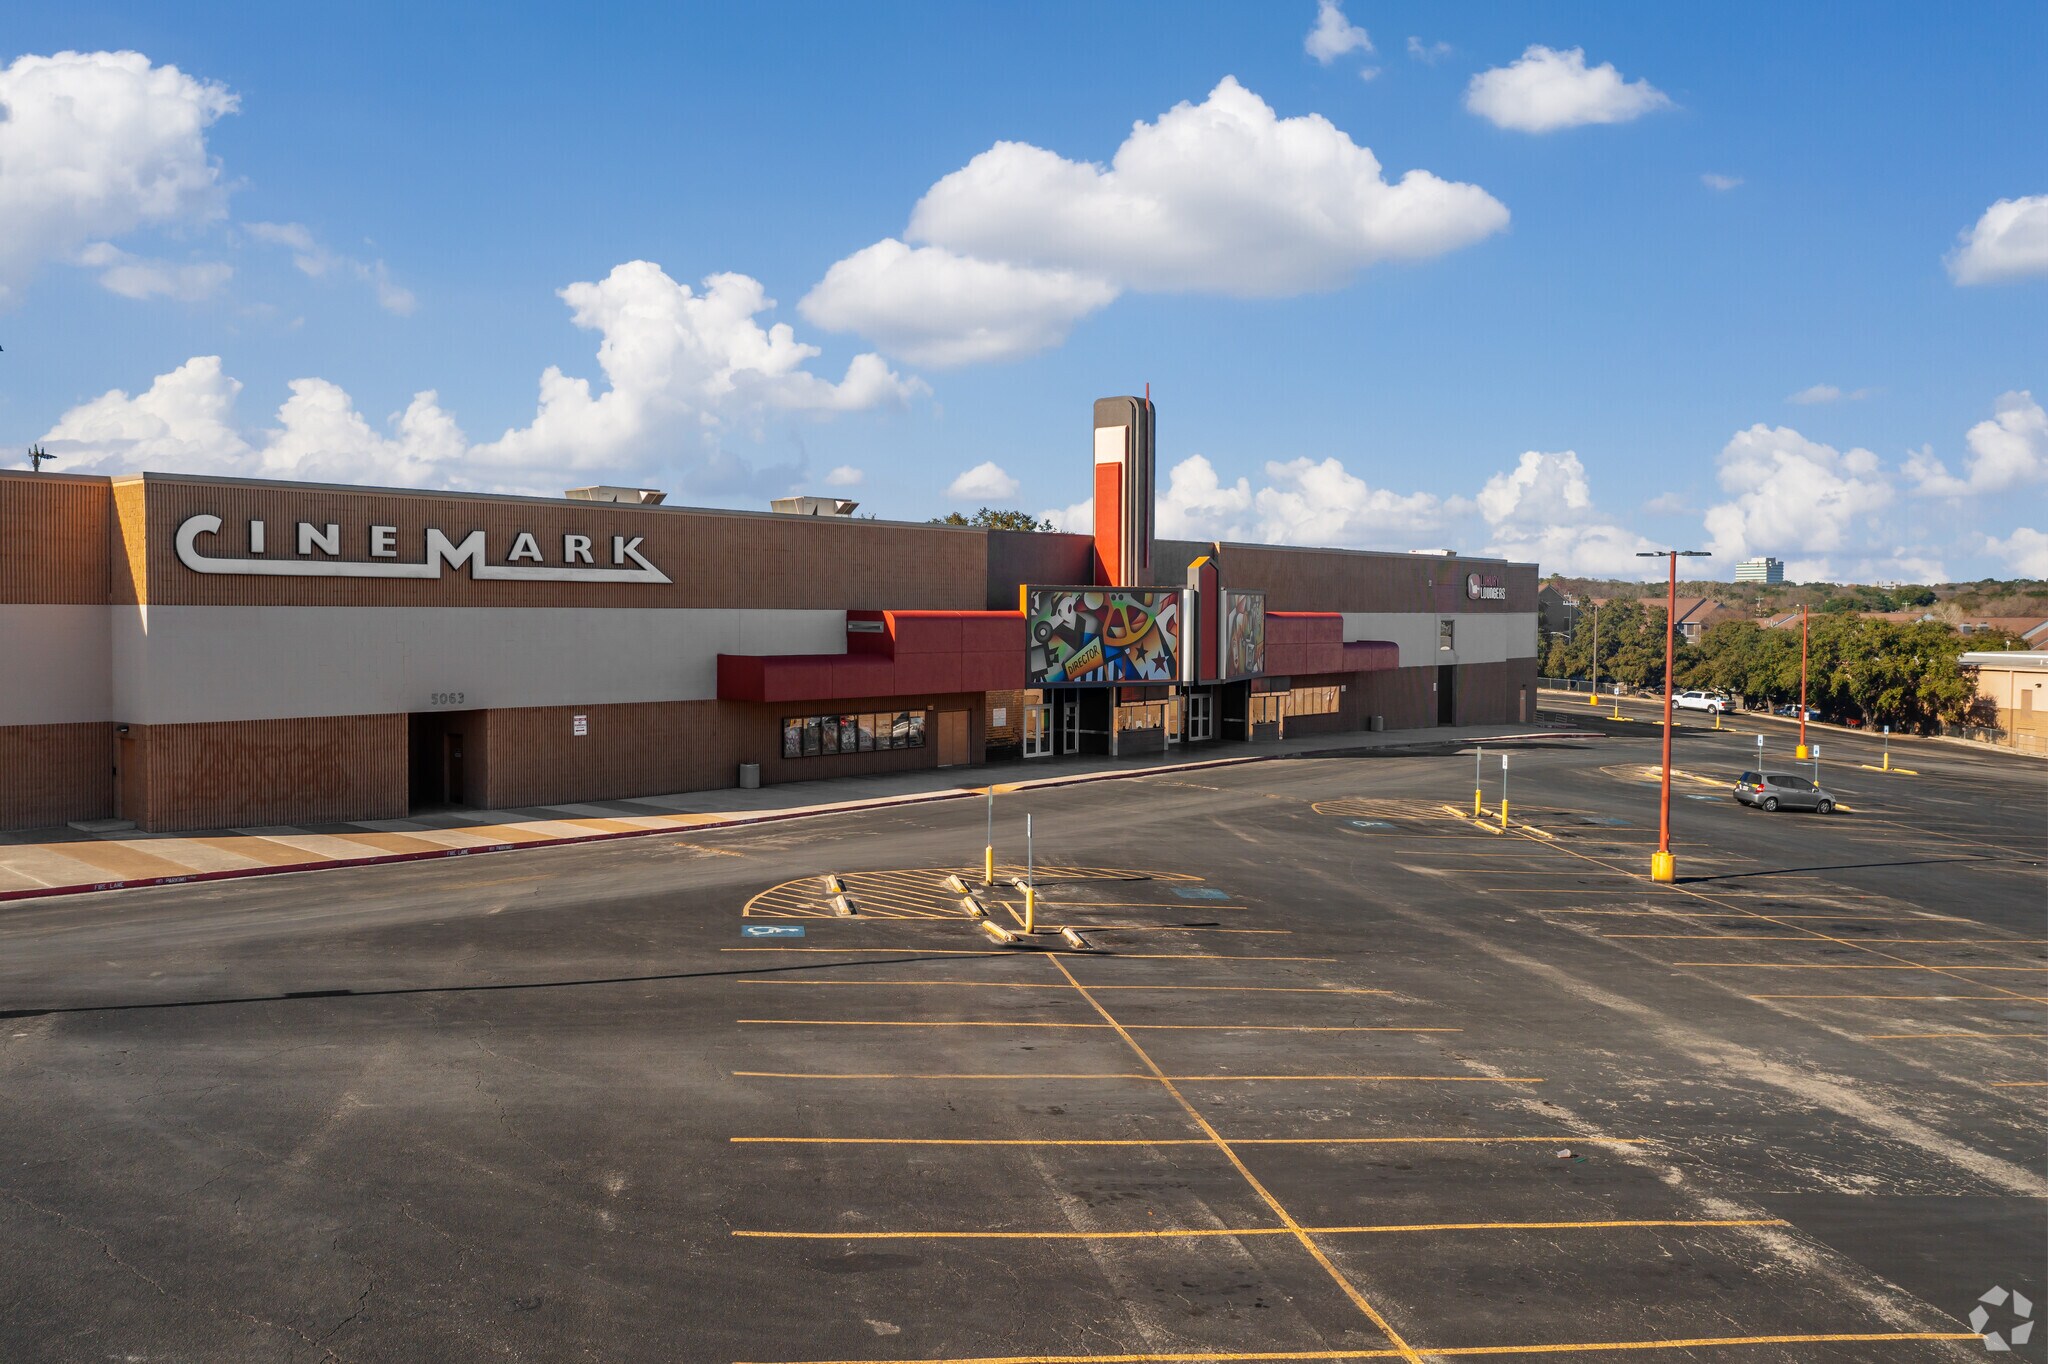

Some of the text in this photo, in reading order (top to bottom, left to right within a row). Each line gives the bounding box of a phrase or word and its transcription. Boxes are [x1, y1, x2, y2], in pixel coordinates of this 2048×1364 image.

[175, 514, 673, 584] CINEMARK
[1067, 645, 1100, 675] DIRECTOR
[431, 692, 465, 705] 5063
